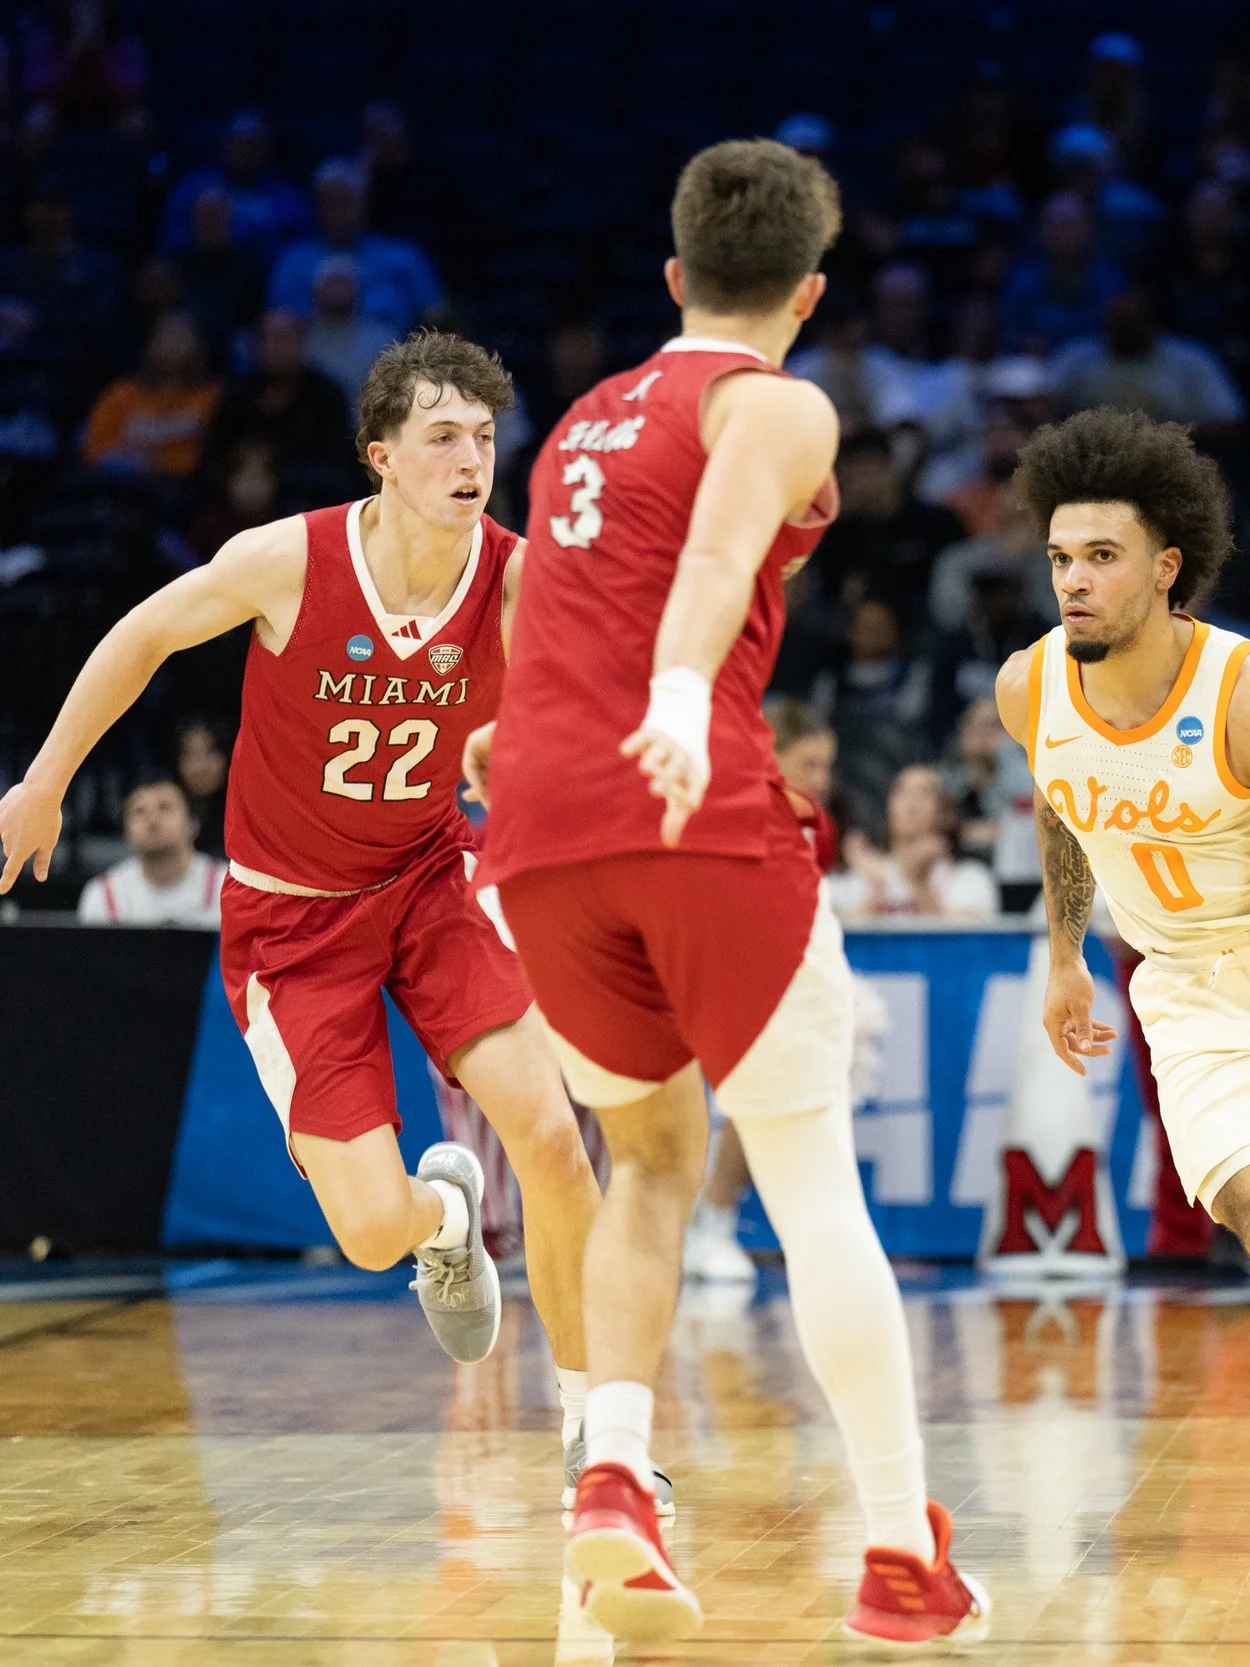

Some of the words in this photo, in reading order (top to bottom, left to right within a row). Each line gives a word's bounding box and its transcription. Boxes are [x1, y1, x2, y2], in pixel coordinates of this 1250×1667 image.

[550, 453, 606, 549] 3
[349, 646, 372, 657] NCAA
[431, 654, 460, 663] MAC
[314, 669, 471, 706] MIAMI
[1174, 748, 1191, 765] SEC
[1180, 729, 1202, 738] NCAA
[321, 718, 441, 802] 22
[1047, 776, 1222, 833] Vols
[1130, 842, 1205, 913] 0
[995, 1147, 1108, 1257] M
